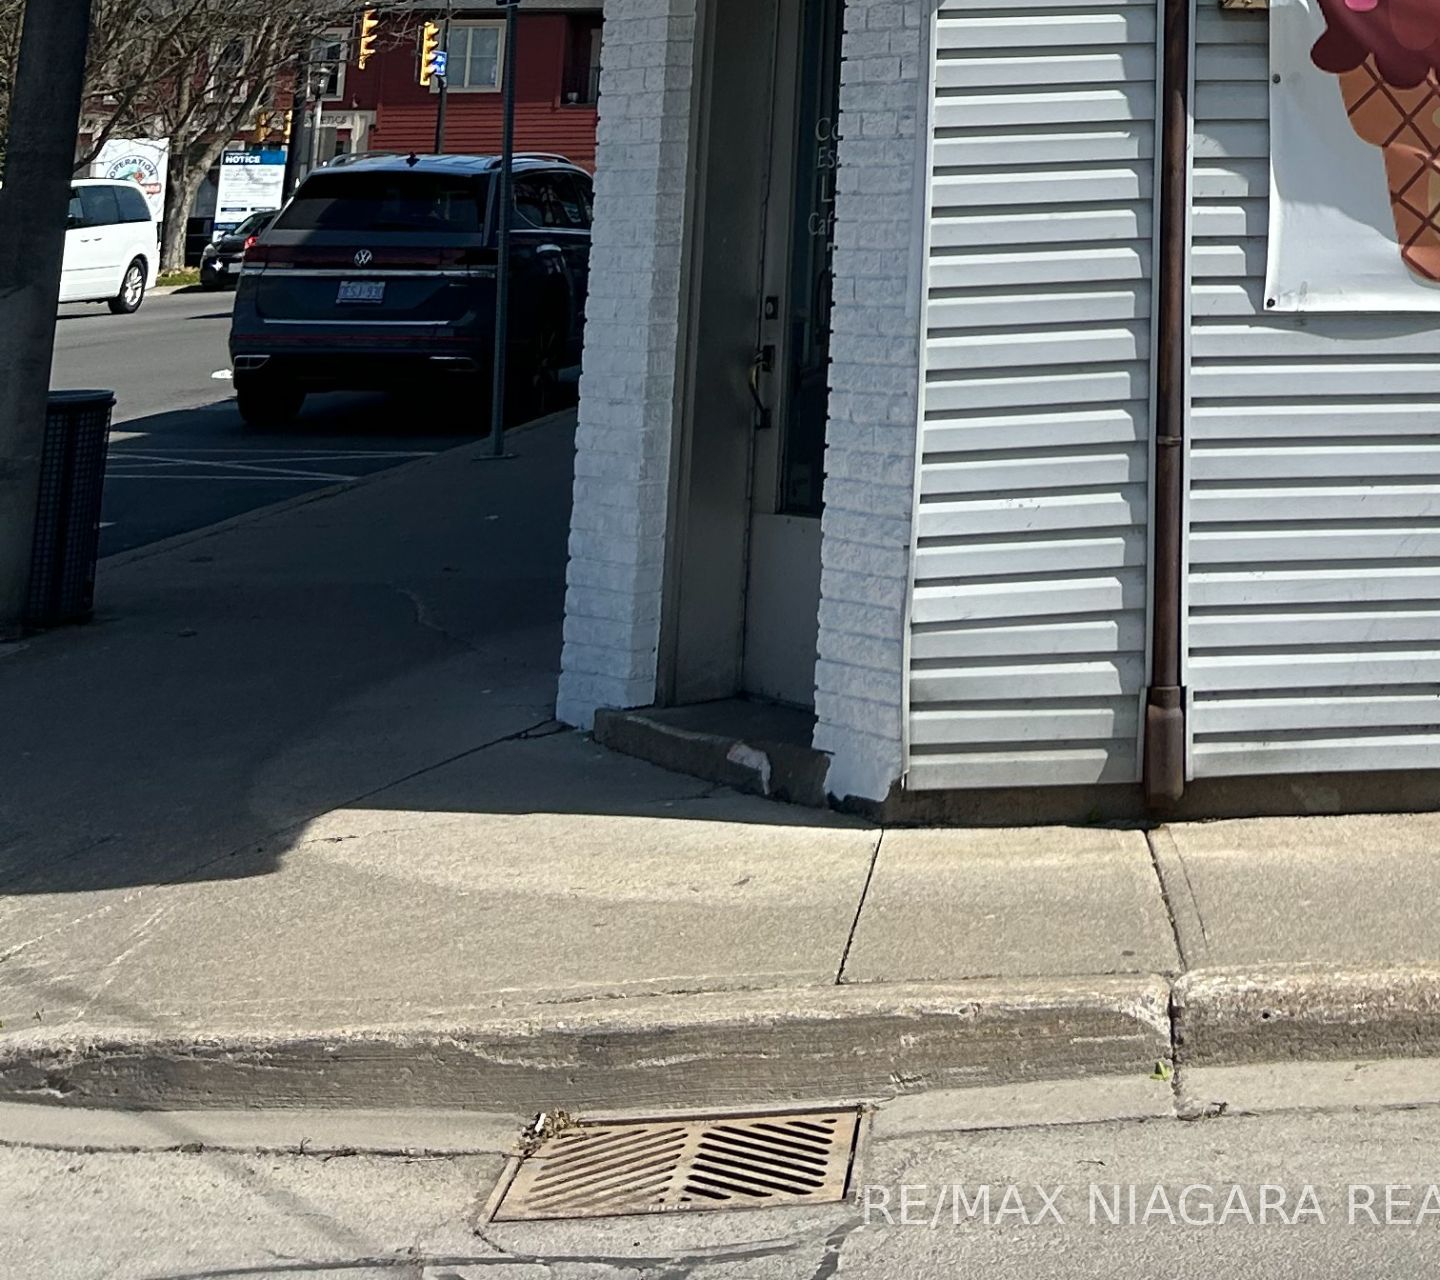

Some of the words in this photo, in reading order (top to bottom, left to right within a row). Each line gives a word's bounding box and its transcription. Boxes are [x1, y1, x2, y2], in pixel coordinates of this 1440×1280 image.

[110, 158, 155, 180] OPERATION
[224, 155, 261, 165] NOTICE
[807, 210, 834, 236] Caf
